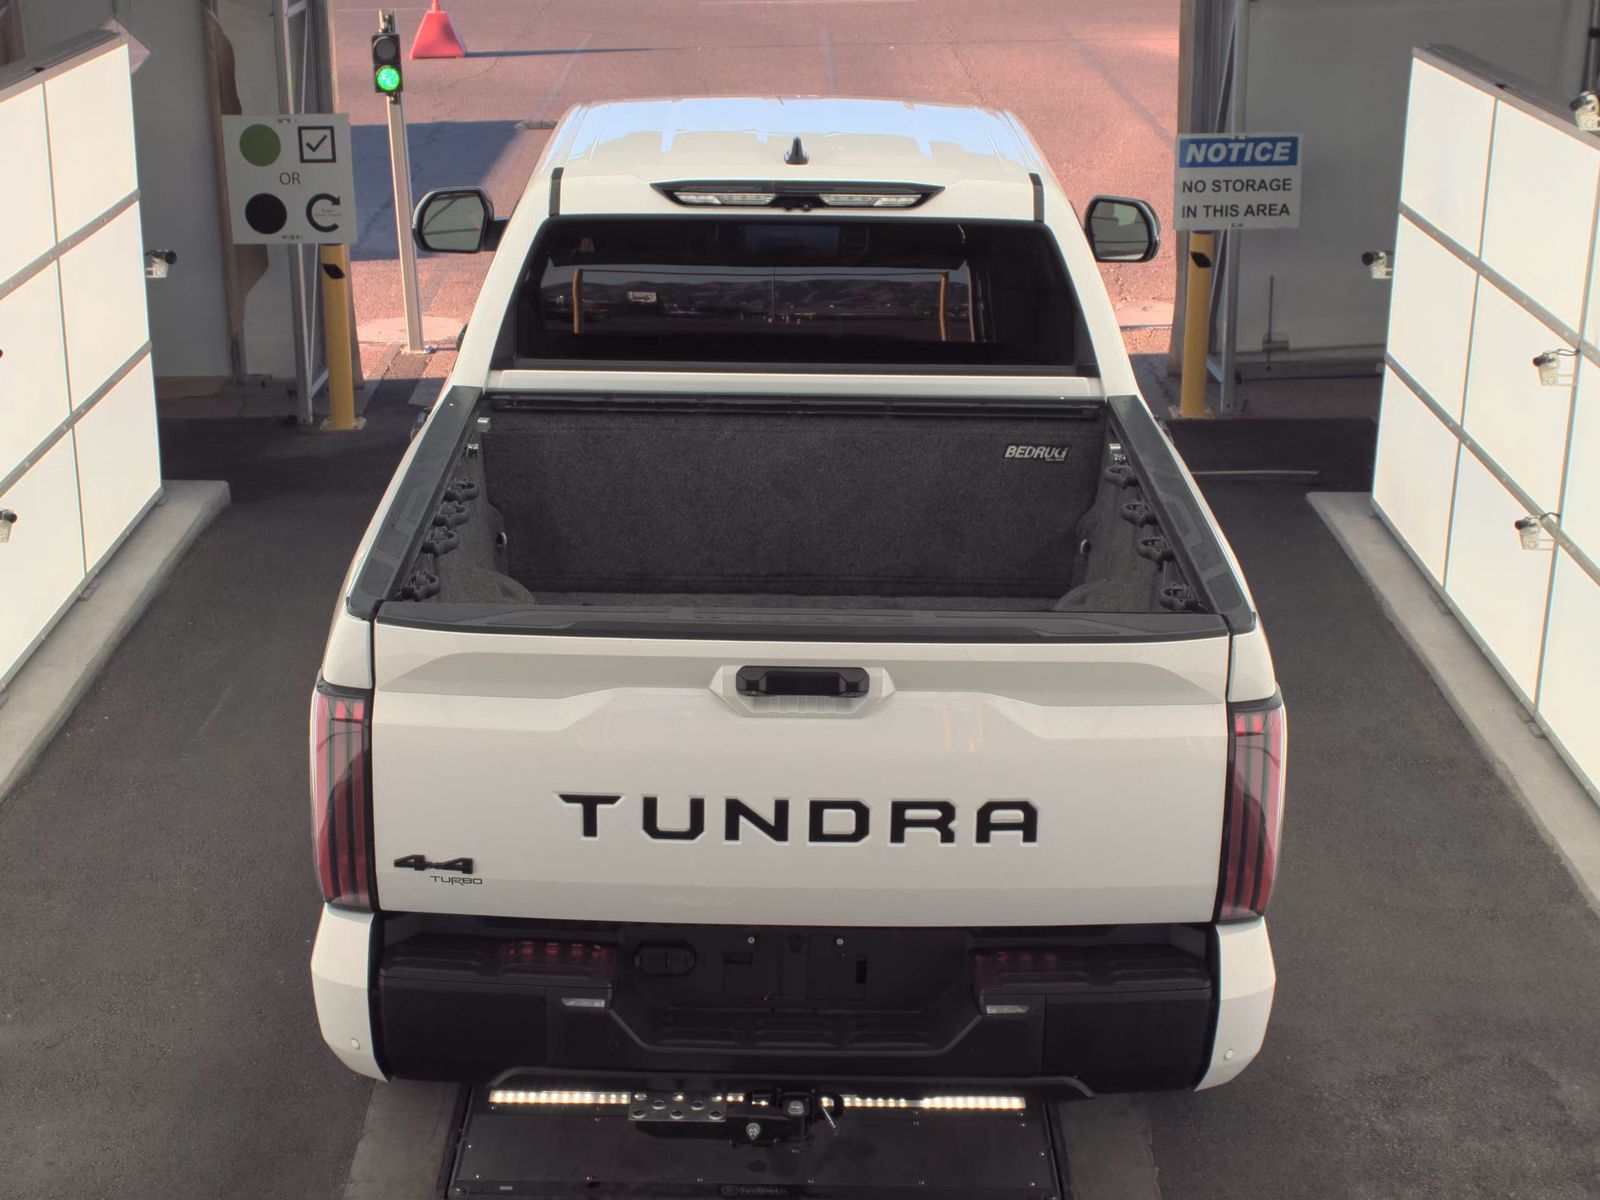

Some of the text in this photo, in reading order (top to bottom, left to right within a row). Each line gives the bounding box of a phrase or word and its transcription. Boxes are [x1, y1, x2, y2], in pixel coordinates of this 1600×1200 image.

[1185, 141, 1292, 163] NOTICE
[279, 172, 301, 185] OR
[1182, 178, 1292, 193] NO STORAGE
[1182, 203, 1290, 218] IN THIS AREA
[556, 792, 1039, 846] TUNDRA
[430, 875, 483, 886] TURBO
